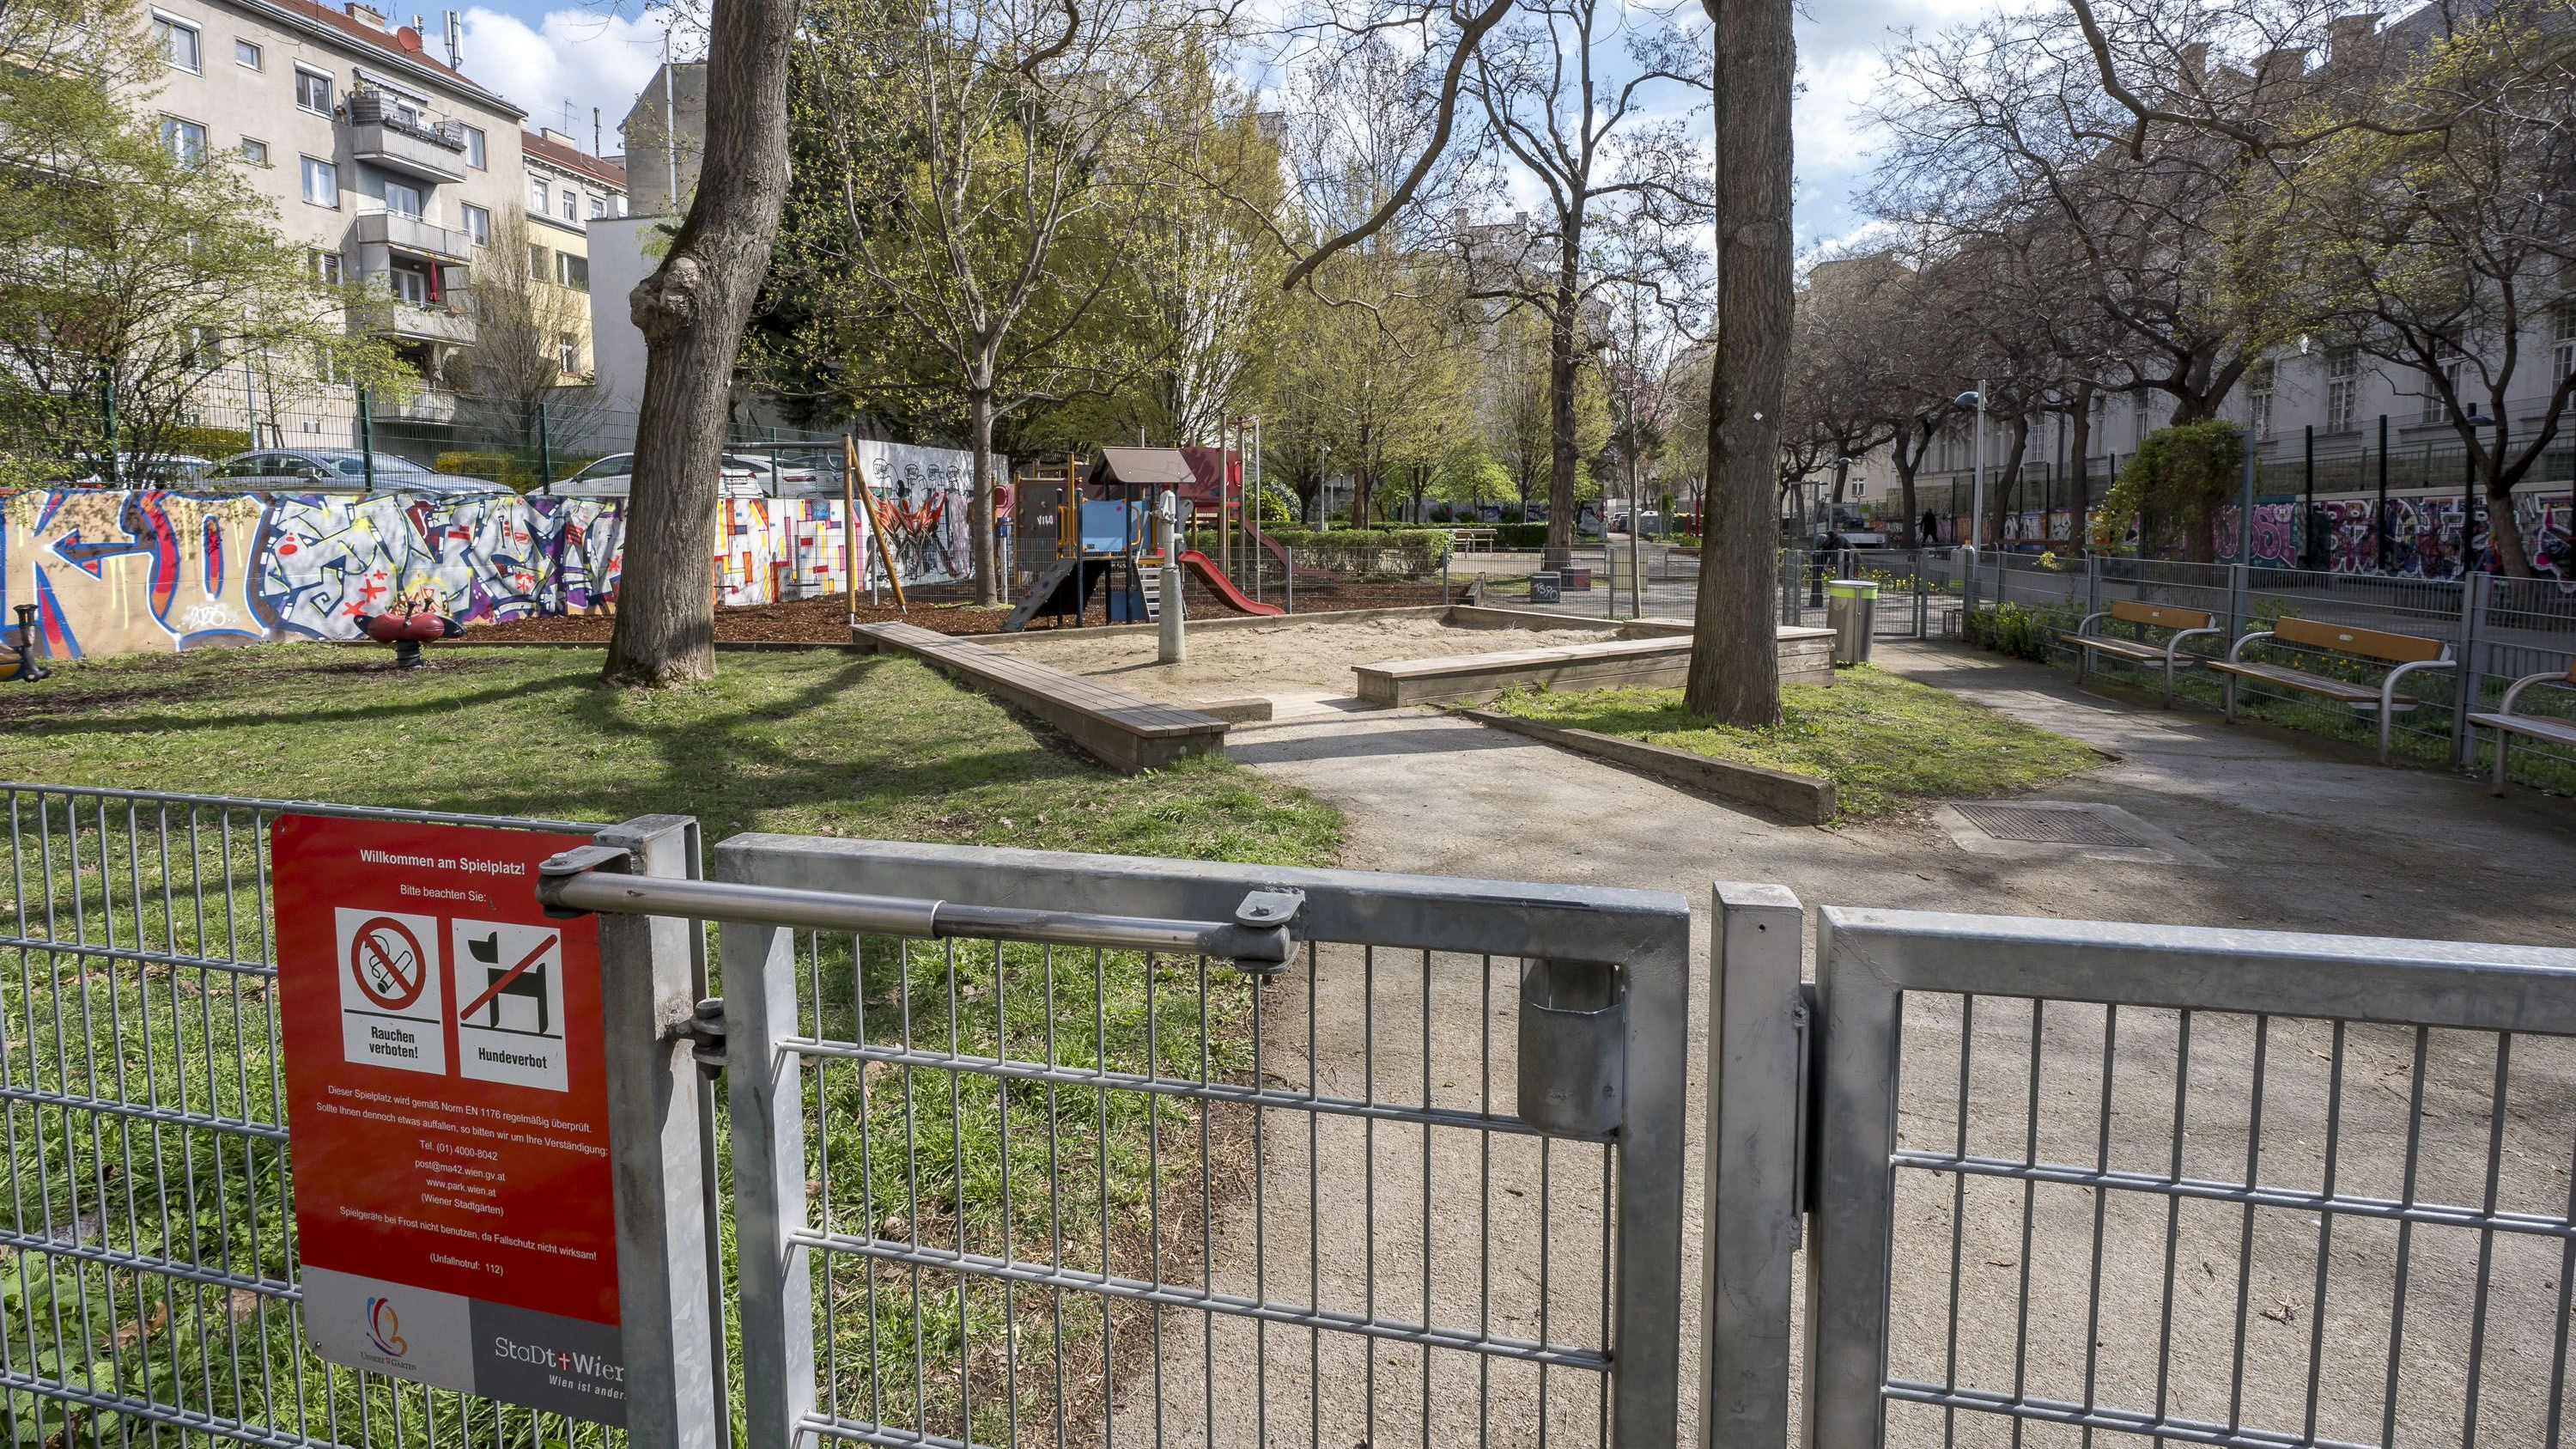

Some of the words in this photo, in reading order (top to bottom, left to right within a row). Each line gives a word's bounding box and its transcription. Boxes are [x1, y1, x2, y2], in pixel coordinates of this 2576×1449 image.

[360, 849, 434, 868] Willkommen
[438, 857, 457, 869] am
[460, 857, 526, 875] Spielplatz!
[400, 884, 421, 897] Bitte
[423, 886, 466, 900] beachten
[468, 890, 487, 902] Sie:
[371, 1026, 415, 1044] Rauchen
[369, 1042, 418, 1059] verboten!
[478, 1047, 548, 1069] Hundeverbot
[328, 1085, 353, 1097] Dieser
[355, 1089, 392, 1103] Spielplatz
[393, 1096, 410, 1105] wird
[411, 1099, 440, 1110] gemäß
[441, 1102, 464, 1114] Norm
[465, 1105, 478, 1117] EN
[481, 1107, 501, 1119] 1176
[502, 1111, 550, 1129] regelmäßig
[551, 1118, 592, 1133] überprüft.
[316, 1101, 337, 1114] Sollte
[339, 1105, 361, 1117] Ihnen
[362, 1109, 396, 1123] dennoch
[398, 1116, 421, 1127] etwas
[422, 1119, 459, 1134] auffallen,
[460, 1126, 471, 1135] so
[472, 1125, 495, 1138] bitten
[496, 1130, 509, 1141] wir
[511, 1134, 525, 1143] um
[526, 1134, 543, 1146] Ihre
[544, 1136, 609, 1158] Verständigung:
[420, 1140, 434, 1151] Tel.
[436, 1142, 453, 1155] (01)
[454, 1146, 498, 1160] 4000-8042
[415, 1160, 506, 1182] post@ma42.wien.gv.at
[426, 1178, 497, 1197] www.park.wien.at
[421, 1192, 453, 1206] (Wiener
[454, 1198, 504, 1217] Stadtgärten)
[339, 1206, 383, 1222] Spielgeräte
[384, 1214, 397, 1225] bei
[398, 1216, 419, 1229] Frost
[420, 1221, 440, 1233] nicht
[440, 1224, 480, 1240] benutzen,
[482, 1232, 492, 1242] da
[494, 1233, 536, 1250] Fallschutz
[537, 1243, 558, 1254] nicht
[559, 1246, 598, 1261] wirksam!
[429, 1252, 481, 1270] (Unfallnotruf:
[485, 1263, 504, 1277] 112)
[549, 1373, 574, 1389] Wien
[577, 1380, 591, 1393] ist
[594, 1385, 627, 1401] ander
